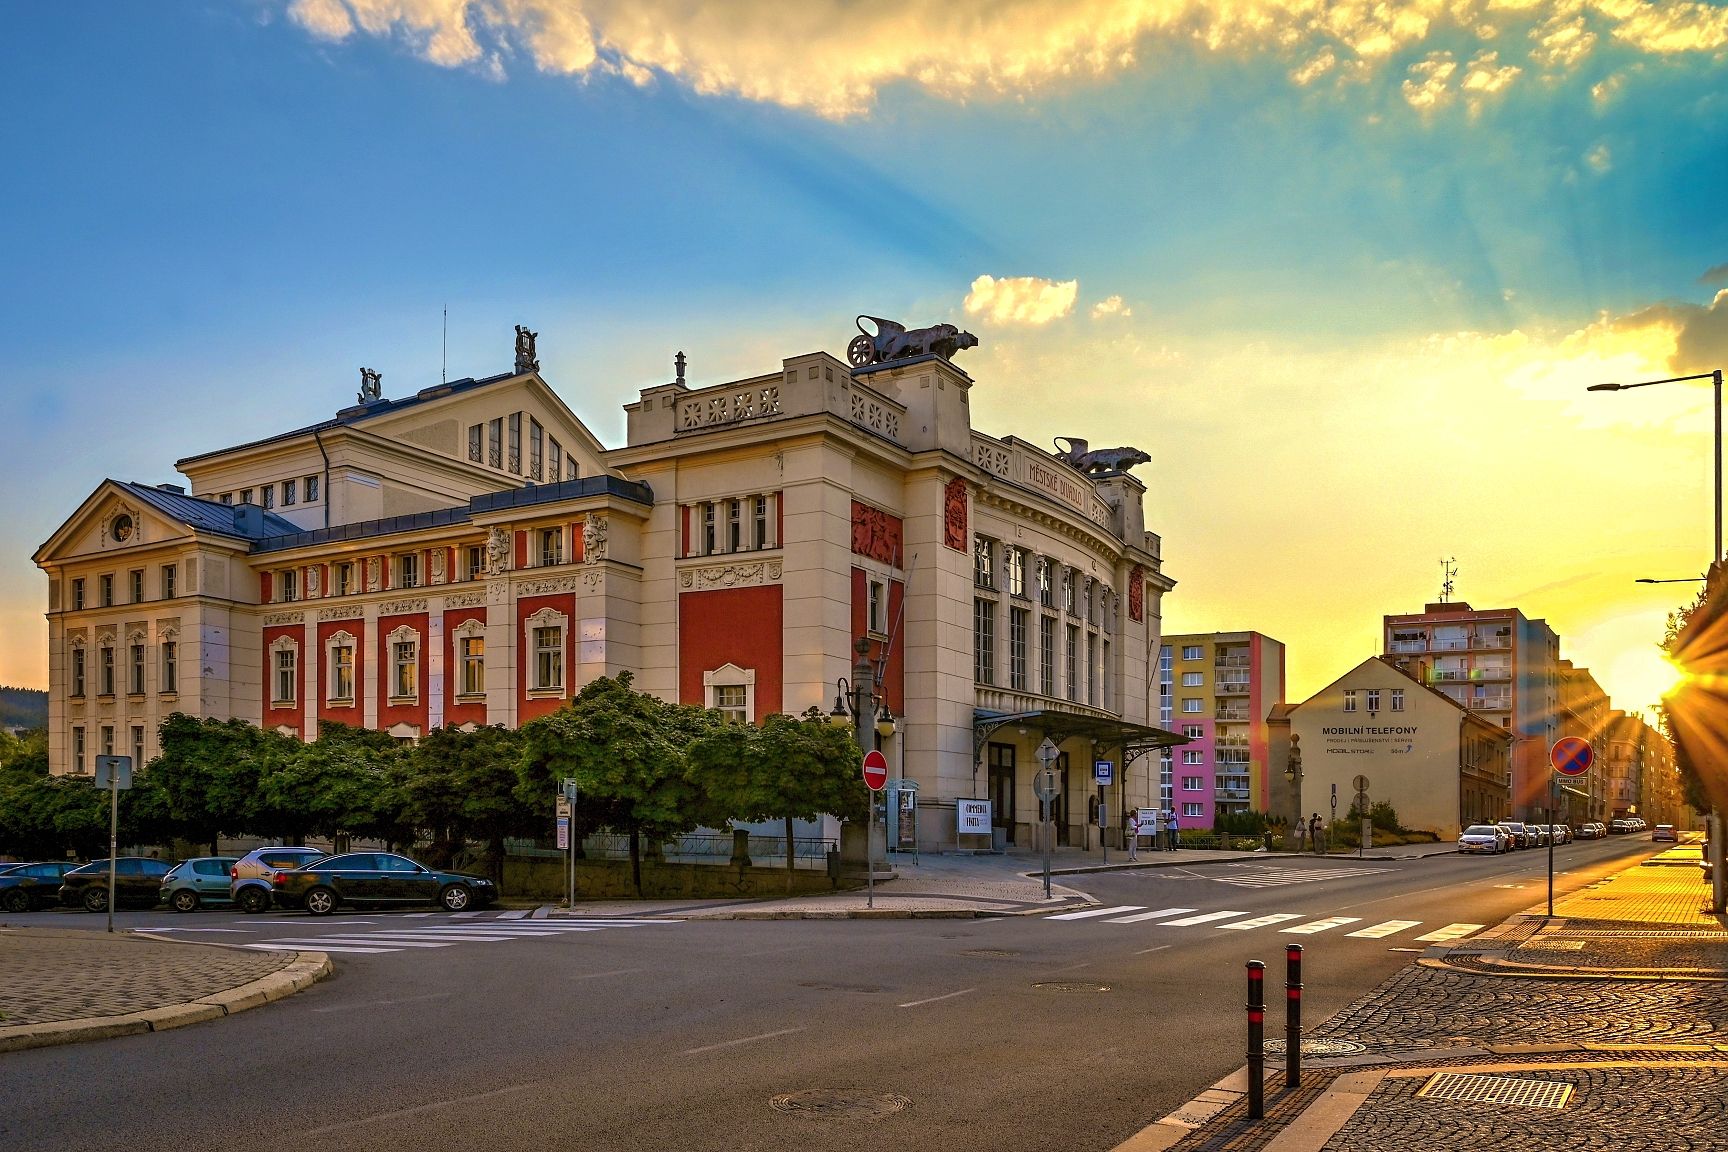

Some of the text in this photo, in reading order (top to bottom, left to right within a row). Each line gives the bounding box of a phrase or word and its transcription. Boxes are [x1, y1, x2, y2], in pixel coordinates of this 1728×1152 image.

[1029, 463, 1058, 492] MĚSTSKÉ
[1322, 726, 1418, 735] MOBILNÍ TELEFONY
